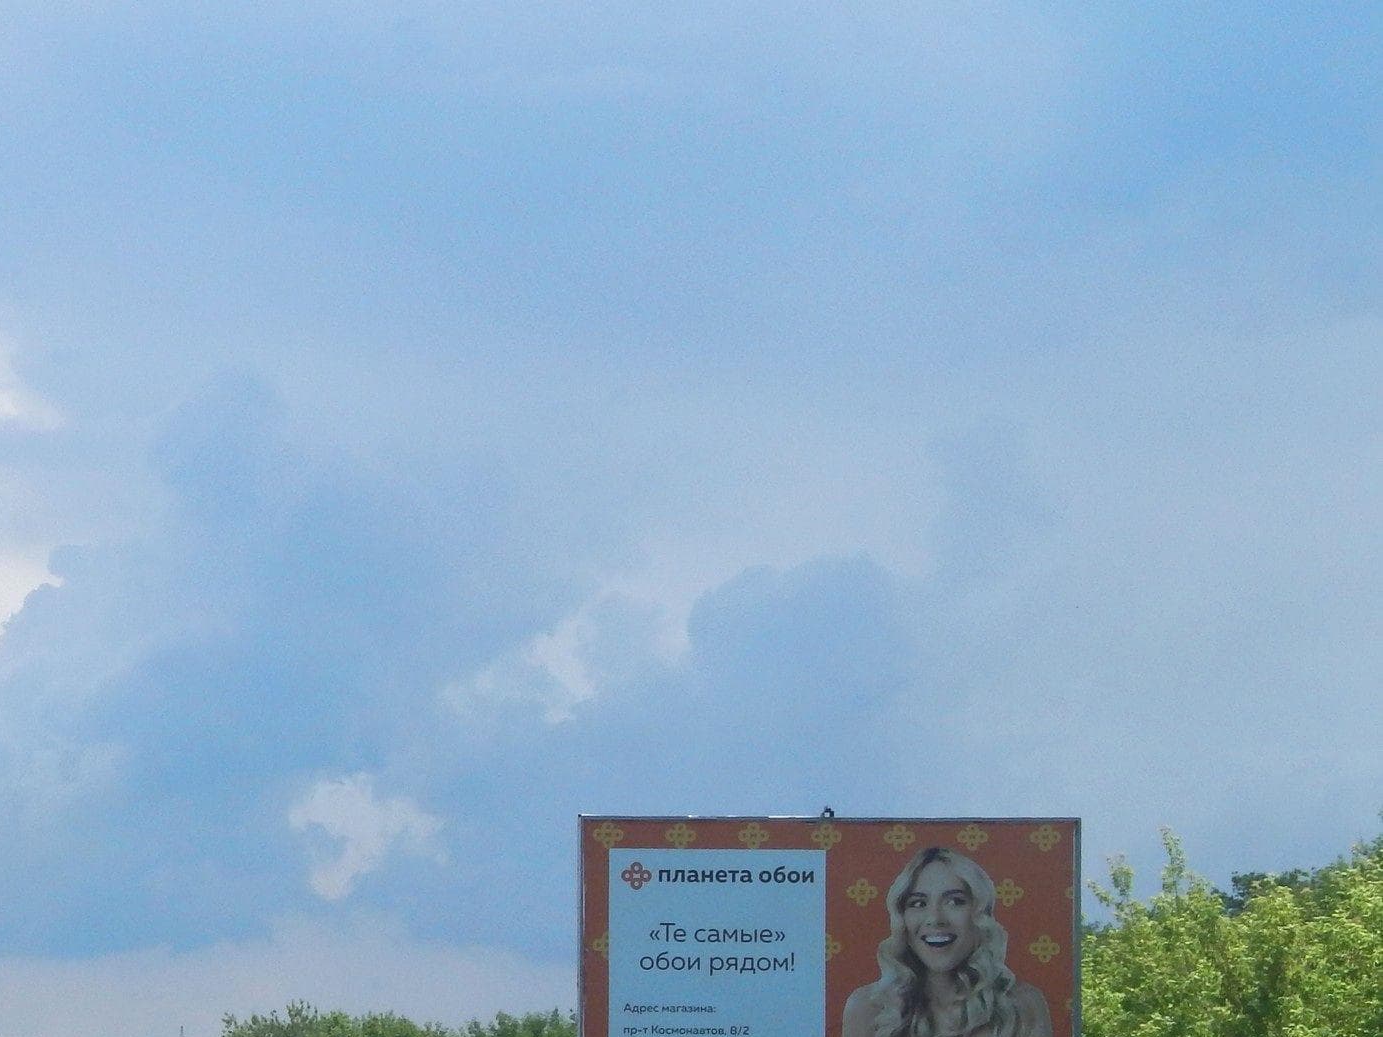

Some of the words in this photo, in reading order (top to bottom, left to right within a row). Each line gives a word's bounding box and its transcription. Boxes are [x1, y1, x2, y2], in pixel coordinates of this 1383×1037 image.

[658, 869, 752, 883] планета
[758, 866, 815, 884] обои
[650, 922, 687, 943] «Те
[694, 928, 786, 943] самые»
[639, 952, 701, 971] обои
[709, 952, 795, 976] рядом!
[623, 1003, 659, 1014] Адрес
[661, 1005, 717, 1014] магазина:
[623, 1027, 648, 1036] пр-т
[651, 1026, 727, 1037] Космонавтов,
[730, 1026, 750, 1036] 8/2
